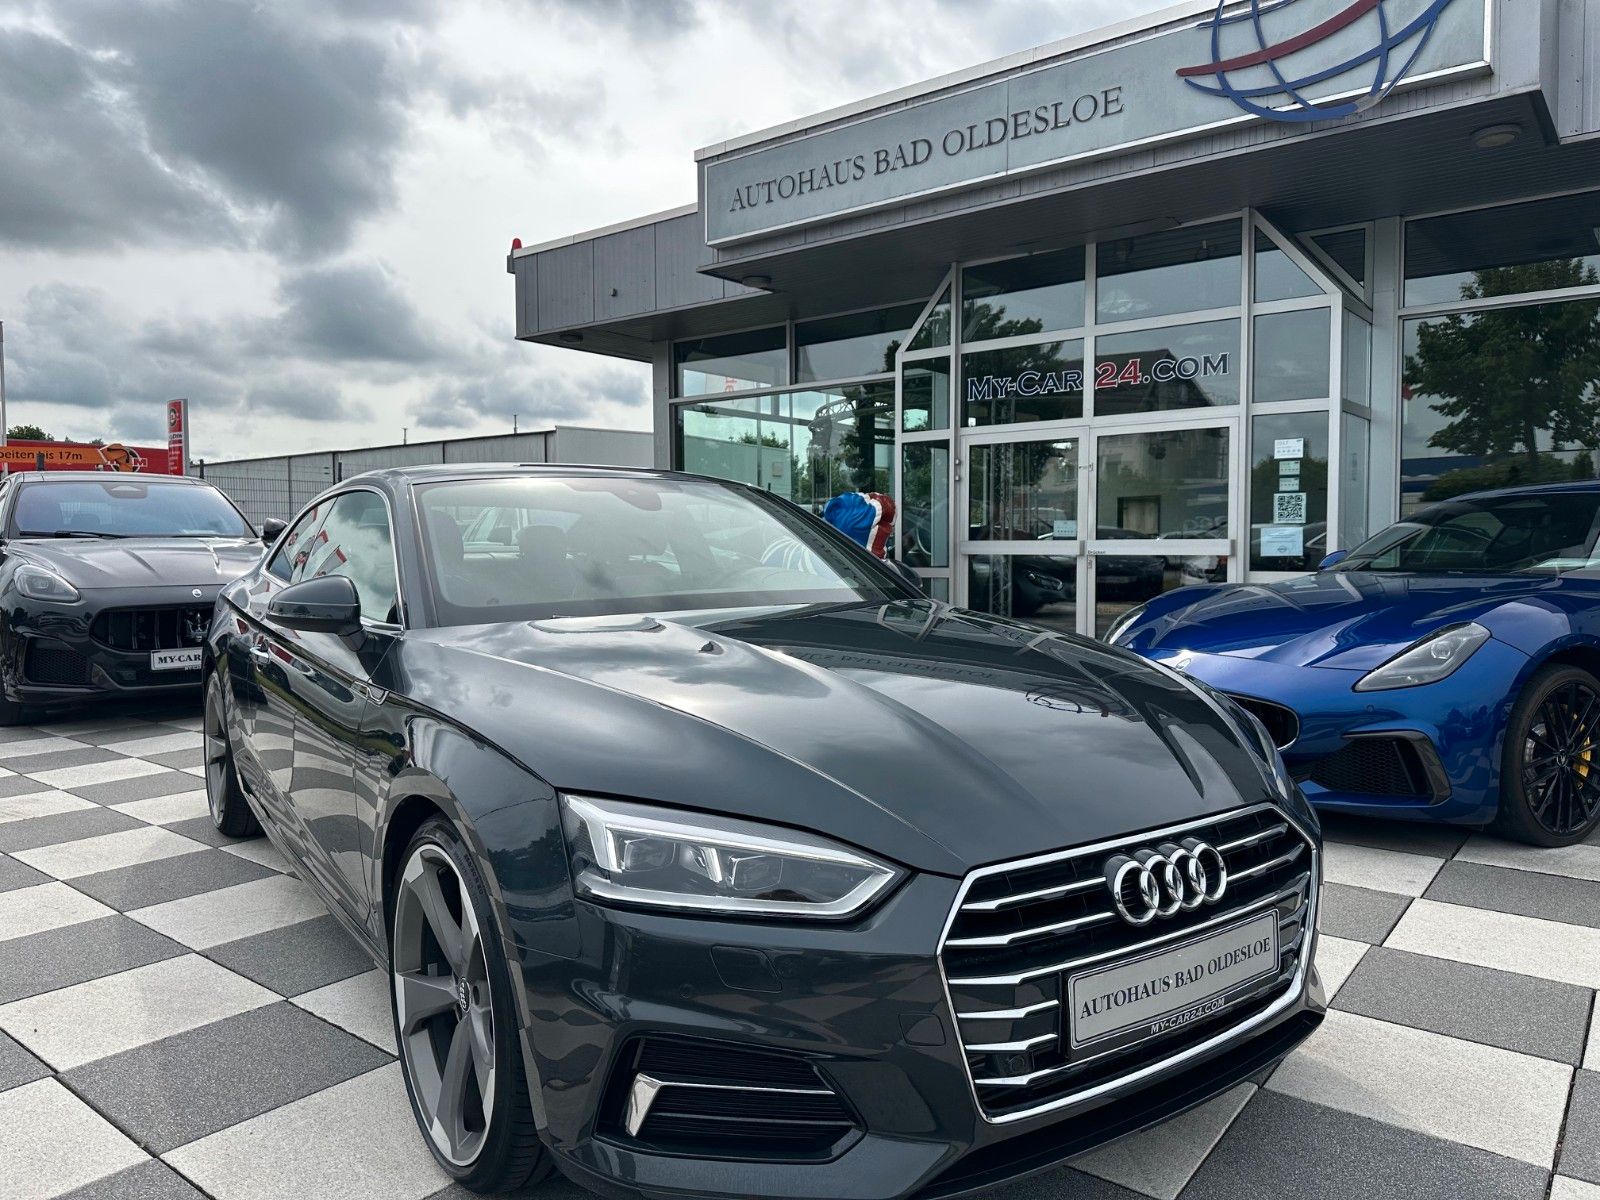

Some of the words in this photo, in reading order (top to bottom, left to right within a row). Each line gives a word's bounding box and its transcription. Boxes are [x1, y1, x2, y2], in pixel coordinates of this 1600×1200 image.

[729, 154, 866, 212] AUTOHAUS
[873, 138, 933, 177] BAD
[942, 86, 1126, 157] OLDESLOE
[38, 450, 55, 460] is
[59, 451, 83, 460] 17m
[1079, 976, 1171, 1020] AUTOHAUS
[1174, 964, 1205, 989] BAD
[1207, 936, 1271, 976] OLDESLOE
[1150, 997, 1226, 1035] MY-CAR24.COM
